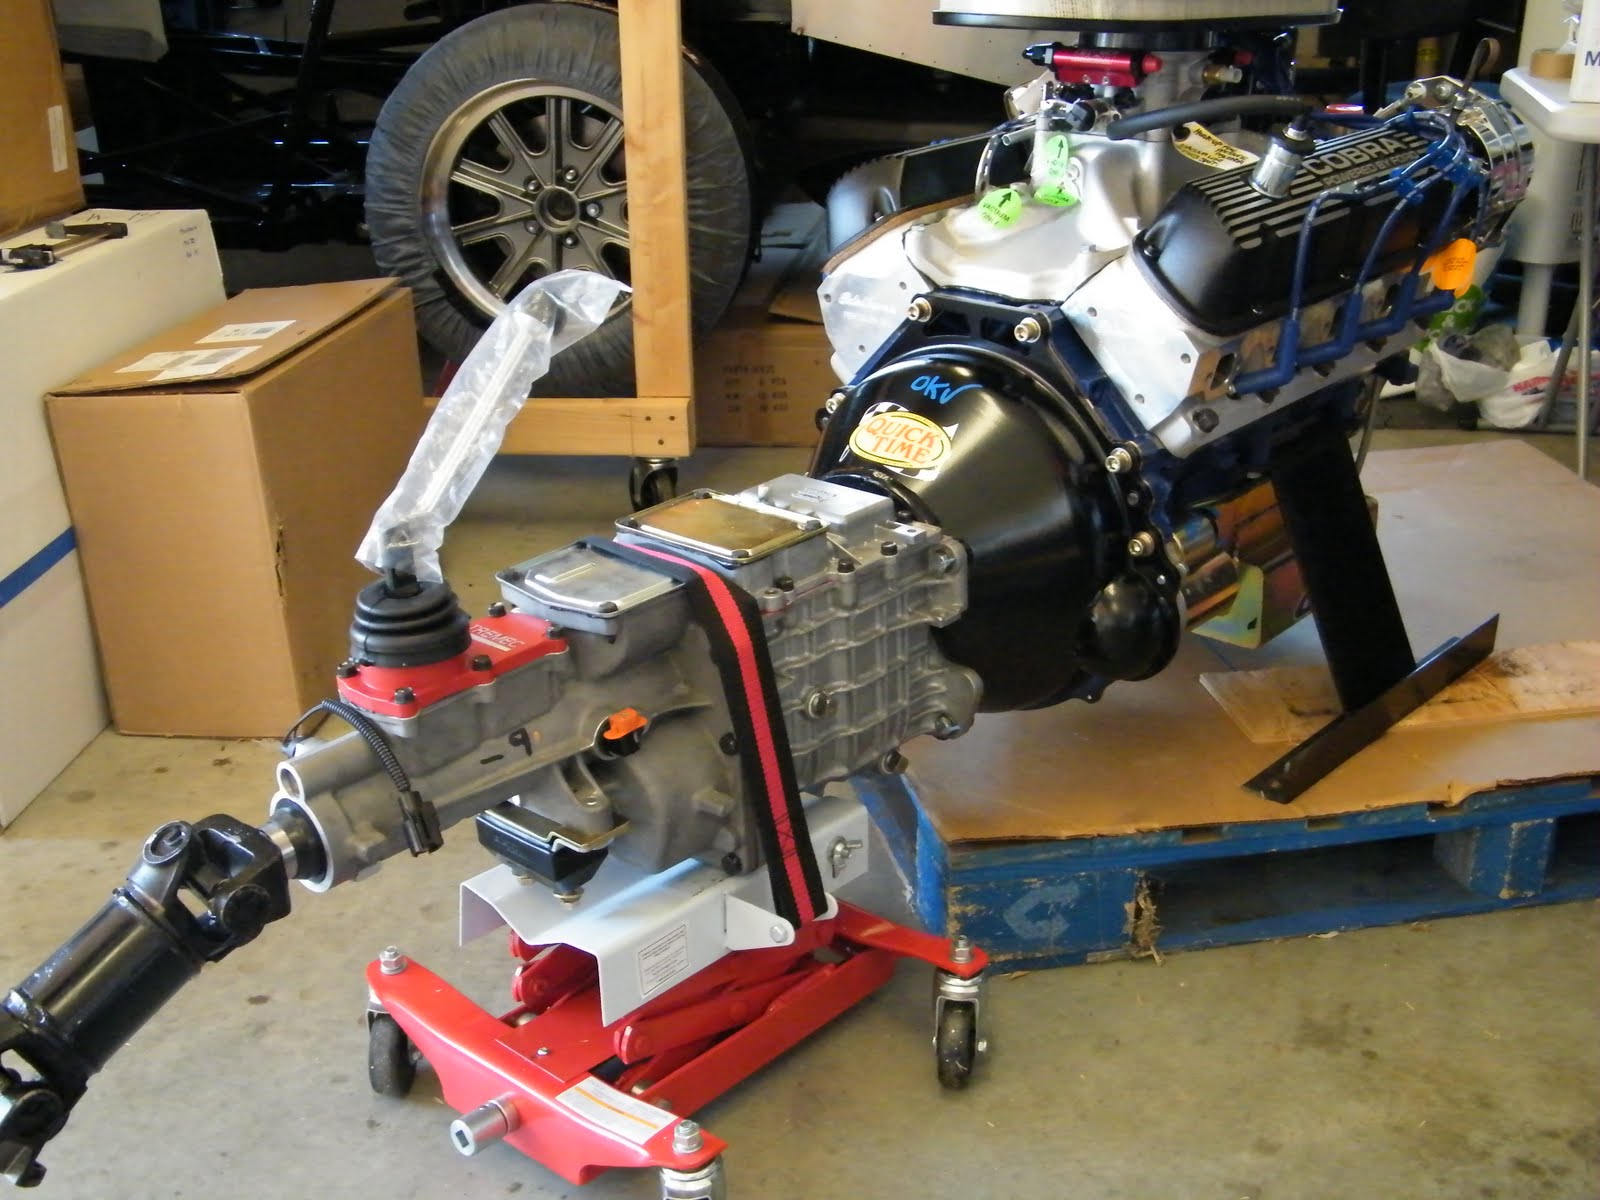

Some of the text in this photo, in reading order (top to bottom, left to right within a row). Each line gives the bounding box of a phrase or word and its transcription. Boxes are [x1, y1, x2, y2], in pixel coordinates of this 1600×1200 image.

[1302, 138, 1407, 175] COBRA
[1322, 150, 1419, 187] POWERED BY FORD
[982, 202, 1010, 222] VACUUM
[865, 417, 940, 449] QUICK
[872, 436, 931, 464] TIME
[469, 624, 525, 648] TREMEC
